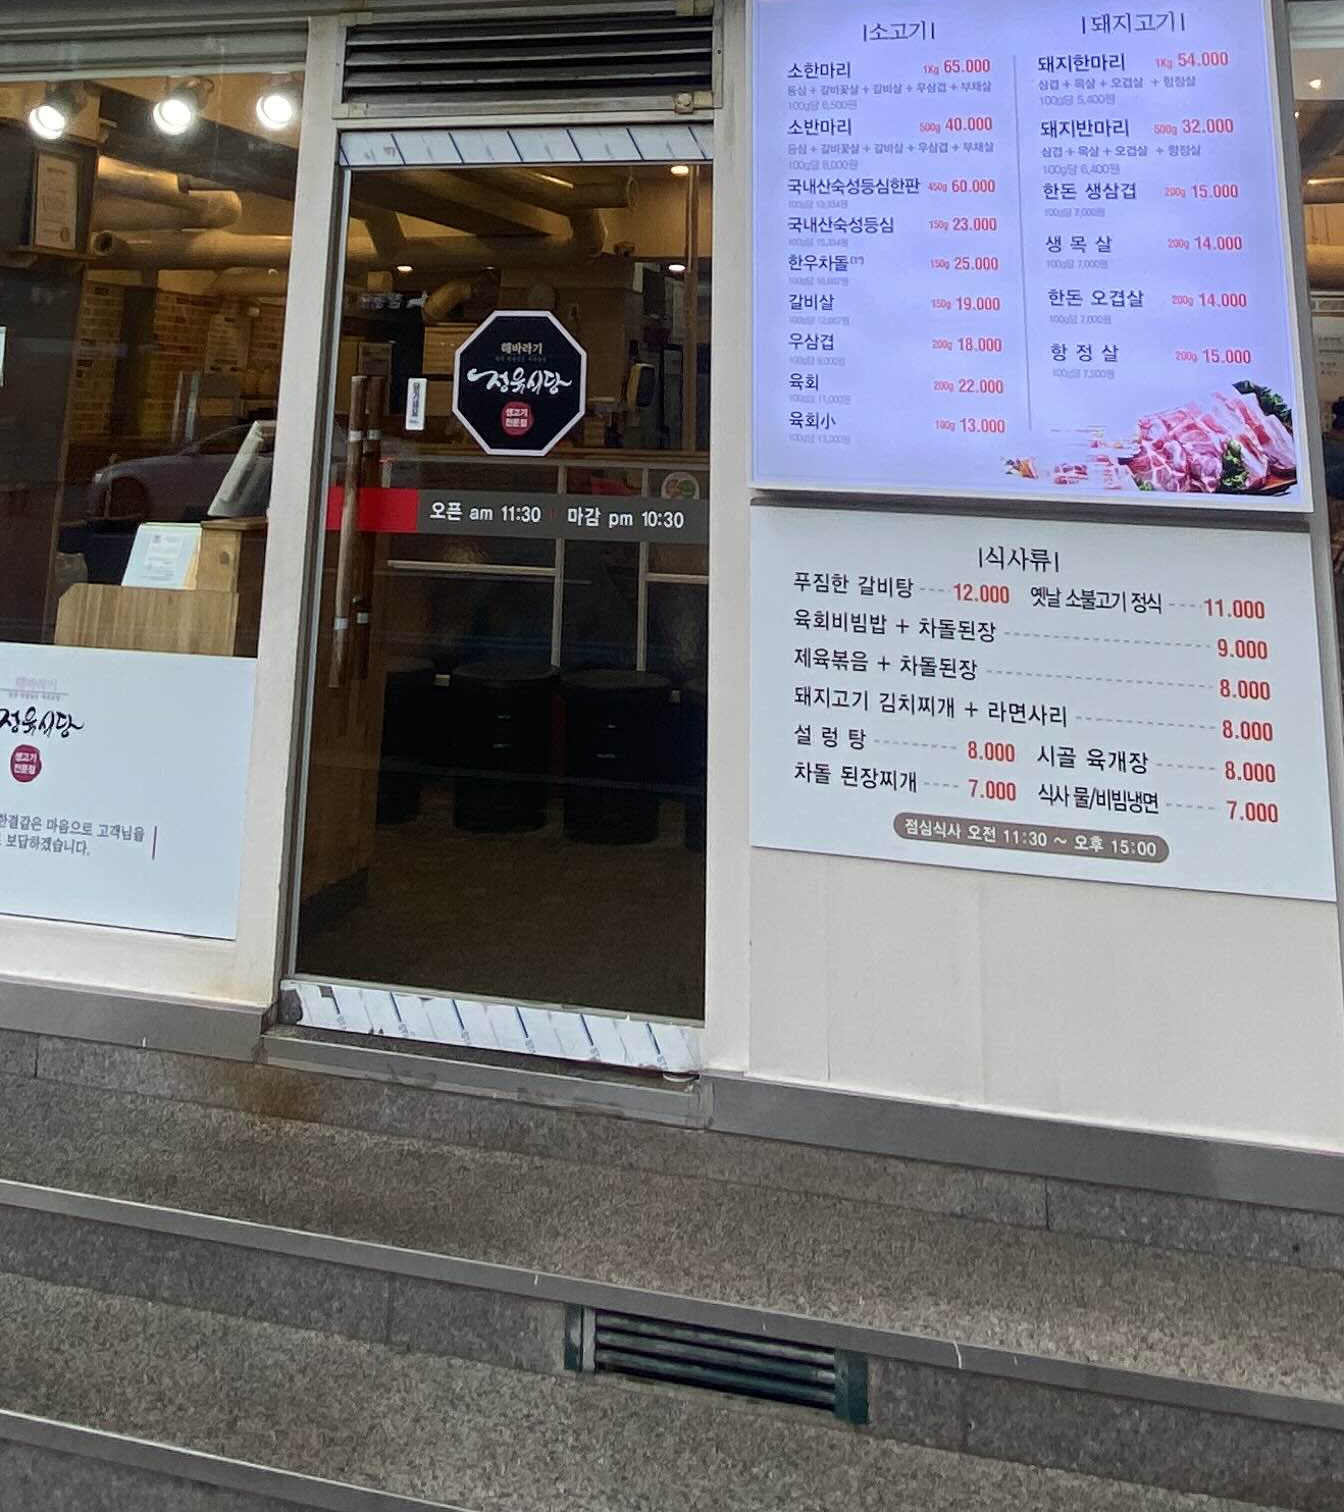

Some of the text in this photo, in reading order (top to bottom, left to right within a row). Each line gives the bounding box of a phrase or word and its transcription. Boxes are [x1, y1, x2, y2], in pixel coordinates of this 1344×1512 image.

[870, 20, 926, 41] 소고기
[1091, 11, 1176, 34] 돼지고기
[787, 59, 990, 79] 소한마리 65.000
[1038, 52, 1228, 73] 돼지한마리 54.000
[787, 119, 852, 136] 소반마리
[946, 117, 993, 132] 40.000
[1040, 118, 1234, 138] 돼지반마리 32.000
[788, 178, 995, 195] 국내산숙성등심한판 60.000
[1043, 182, 1238, 200] 한돈 생삼겹 15.000
[788, 217, 894, 233] 국내산숙성등심
[953, 217, 997, 232] 23.000
[1195, 236, 1242, 251] 14.000
[954, 257, 999, 271] 25.000
[789, 294, 835, 311] 갈비살
[956, 297, 1000, 311] 19.000
[1048, 289, 1083, 307] 한돈
[1091, 290, 1144, 308] 오겹살
[1199, 293, 1247, 308] 14.000
[789, 333, 835, 351] 우삼겹
[959, 338, 1002, 352] 18.000
[1202, 349, 1251, 364] 15.000
[467, 366, 572, 395] 정육식당
[789, 372, 819, 392] 육회
[959, 379, 1003, 394] 22.000
[960, 418, 1005, 434] 13.000
[429, 502, 684, 529] 오픈 am 11:30 마감 pm 10:30
[985, 546, 1052, 573] 식사류
[794, 571, 1265, 619] 푸짐한 갈비탕 12.000 옛날 소불고기 정식 11.000
[794, 608, 1268, 660] 육회비빔밥 차돌된장 9.000
[794, 648, 1271, 701] 제육볶음 차돌된장 8.000
[794, 686, 1273, 741] 돼지고기 김치찌개 라면사리 8.000
[968, 741, 1015, 762] 8.000
[1037, 745, 1076, 769] 시골
[1087, 748, 1149, 775] 육개장
[1225, 760, 1276, 783] 8.000
[794, 762, 1279, 823] 차돌 된장찌개 7.000 식사 물/비빔냉면 7.000
[47, 819, 93, 837] 마음으로
[97, 824, 144, 842] 고객님을
[905, 818, 1156, 857] 점심식사 오전 11:30 오후 15:00
